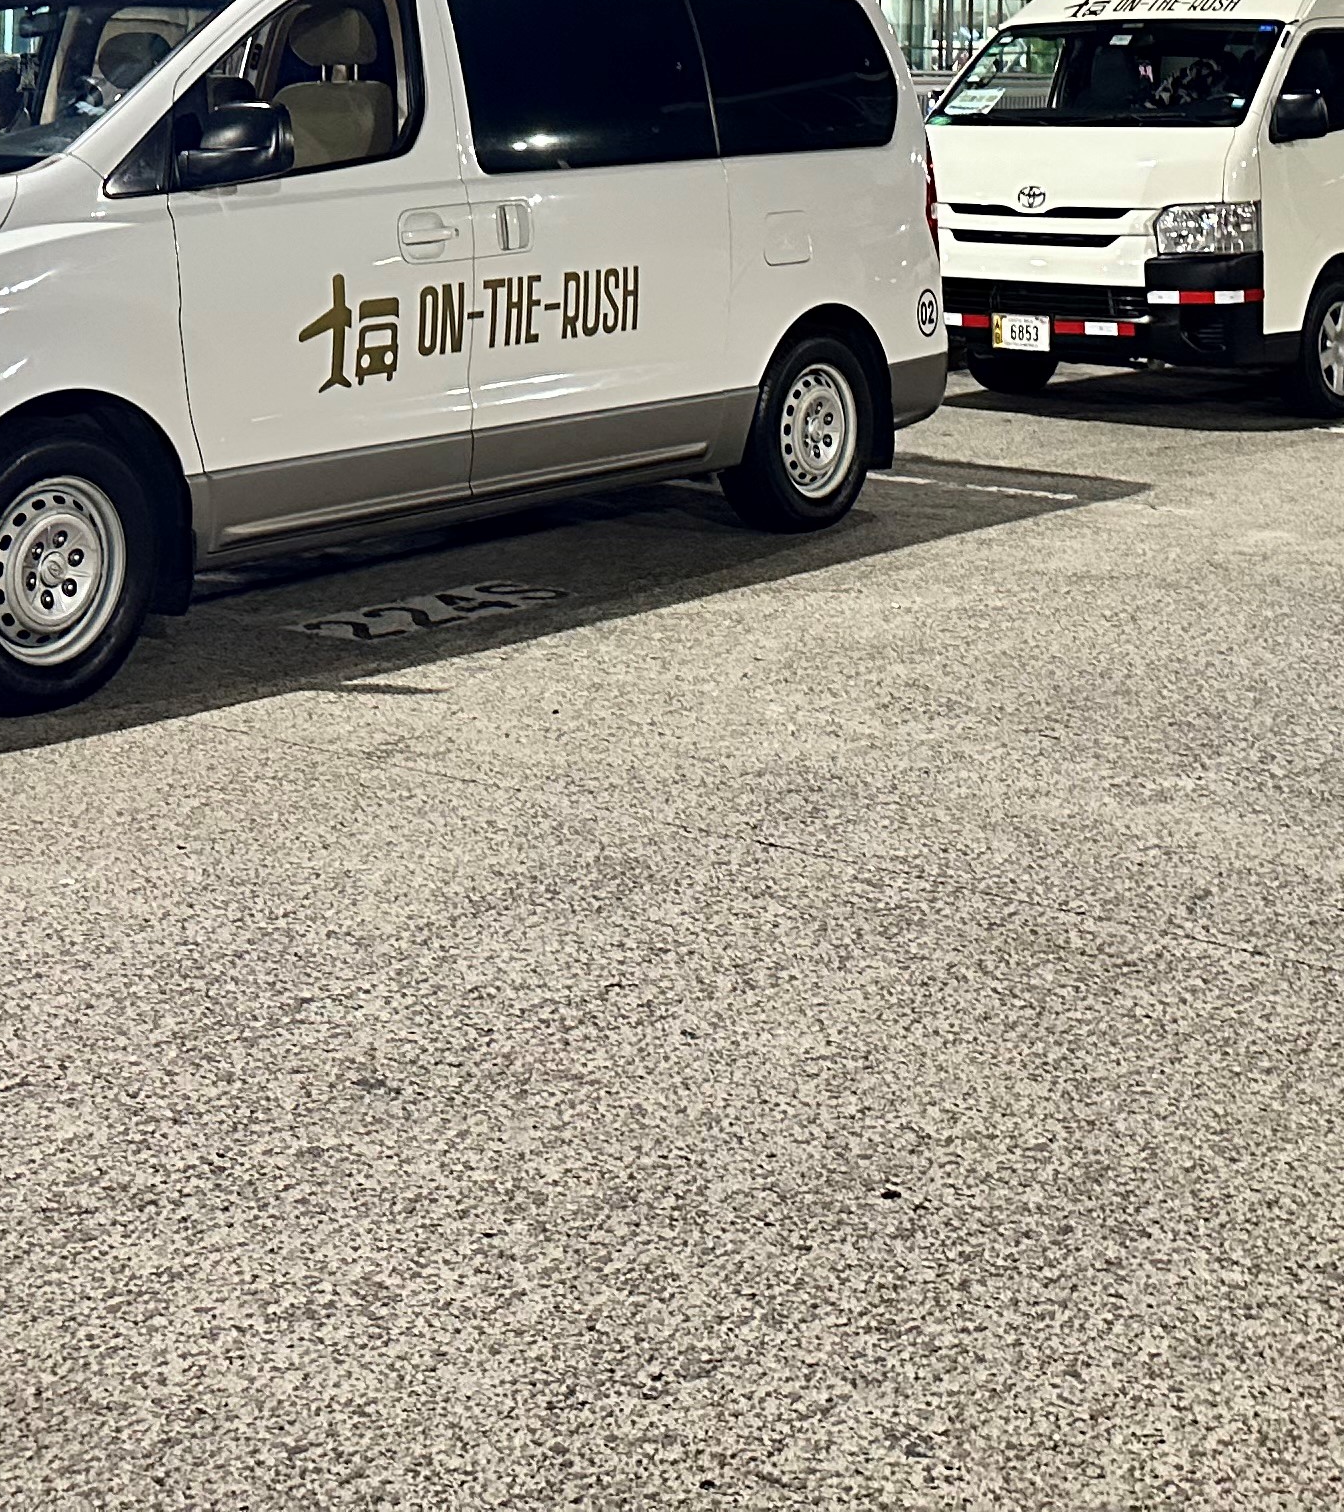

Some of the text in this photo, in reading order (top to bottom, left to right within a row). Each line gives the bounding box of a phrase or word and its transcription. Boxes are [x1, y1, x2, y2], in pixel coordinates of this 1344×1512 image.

[417, 265, 640, 357] ON-THE-RUSH
[920, 300, 935, 326] 02
[1010, 324, 1039, 342] 6853
